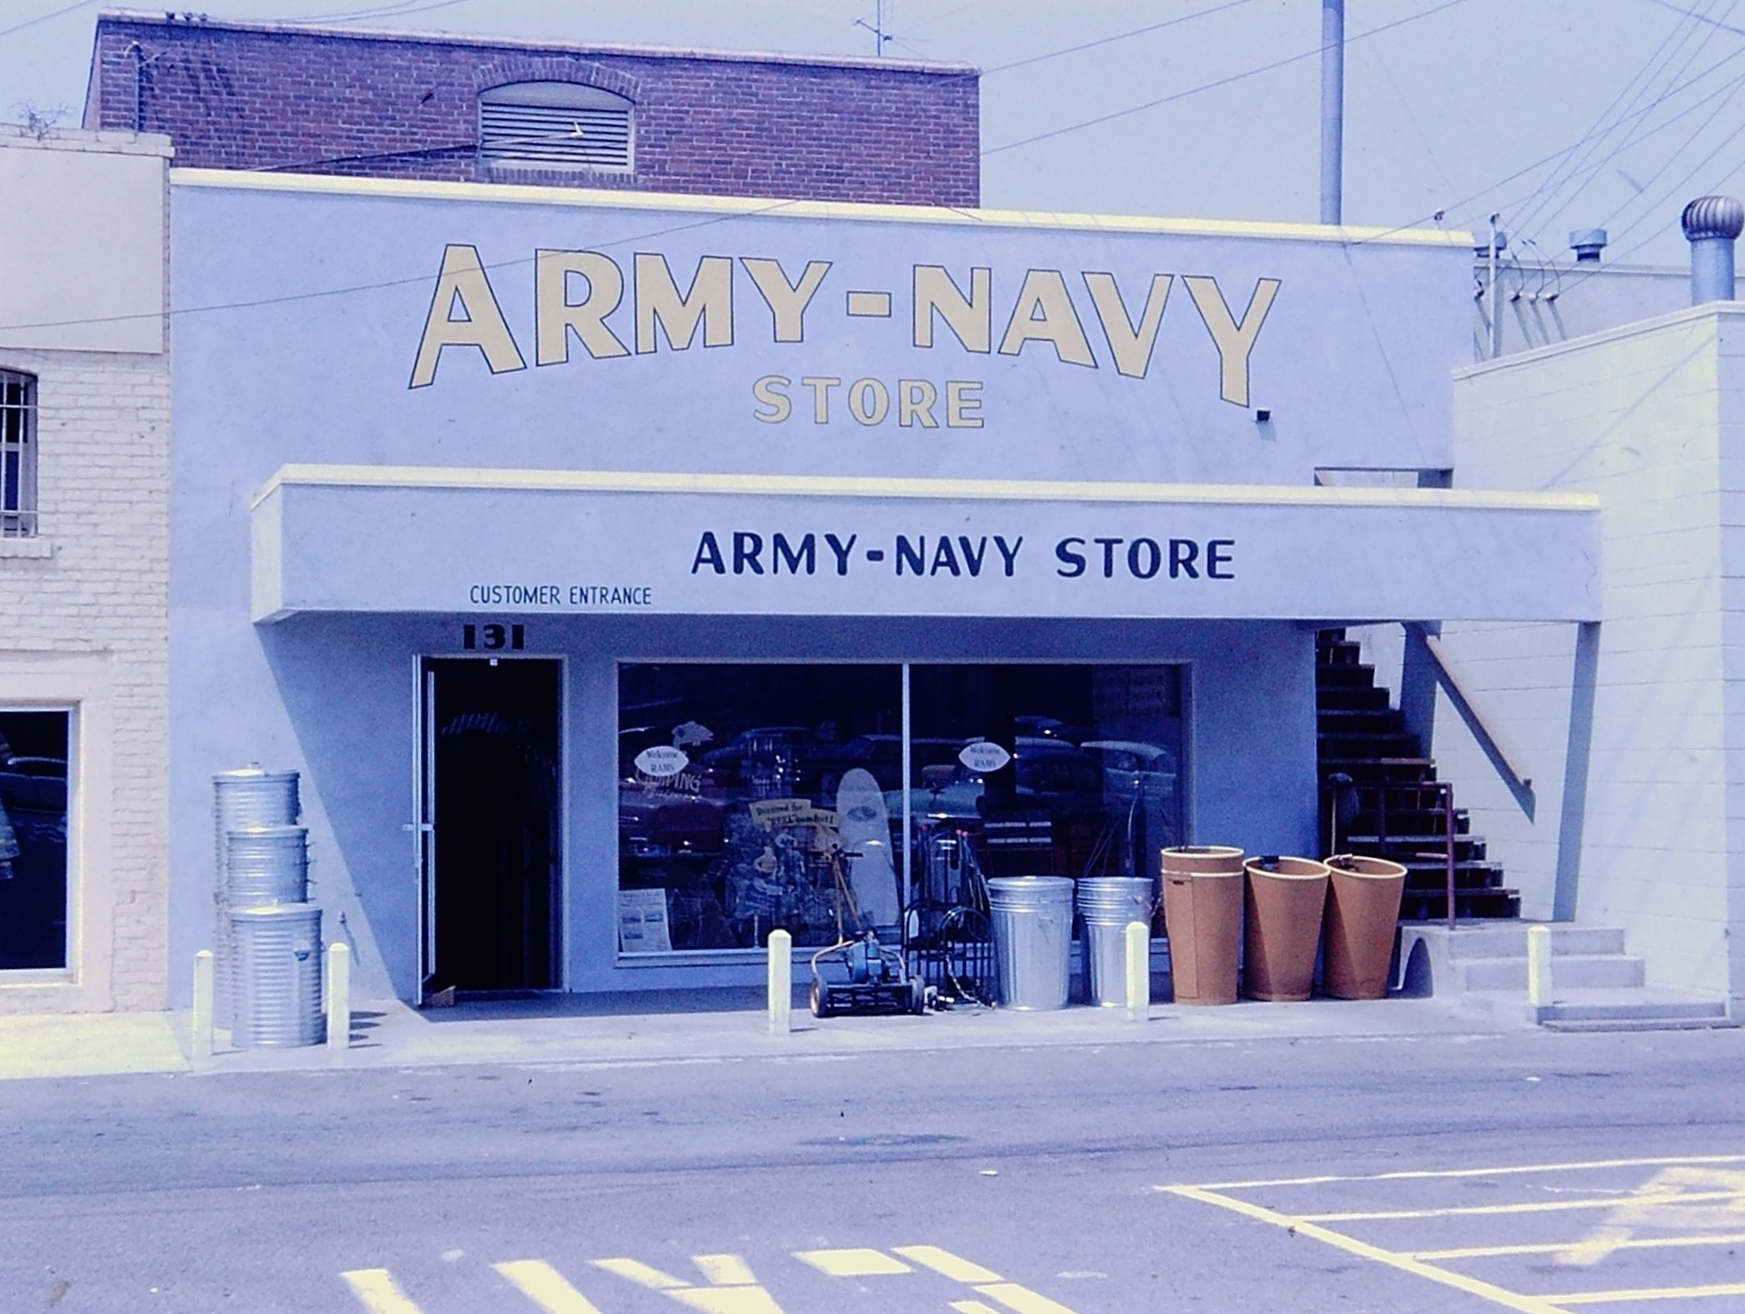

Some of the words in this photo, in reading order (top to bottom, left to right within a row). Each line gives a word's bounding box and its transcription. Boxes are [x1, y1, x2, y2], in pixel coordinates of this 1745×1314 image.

[408, 244, 1282, 408] ARMY-NAVY
[753, 375, 985, 429] STORE
[691, 531, 1023, 577] ARMY-NAVY
[1055, 537, 1236, 580] STORE
[470, 585, 561, 606] CUSTOMER
[569, 586, 652, 606] ENTRANCE
[464, 624, 524, 650] 131
